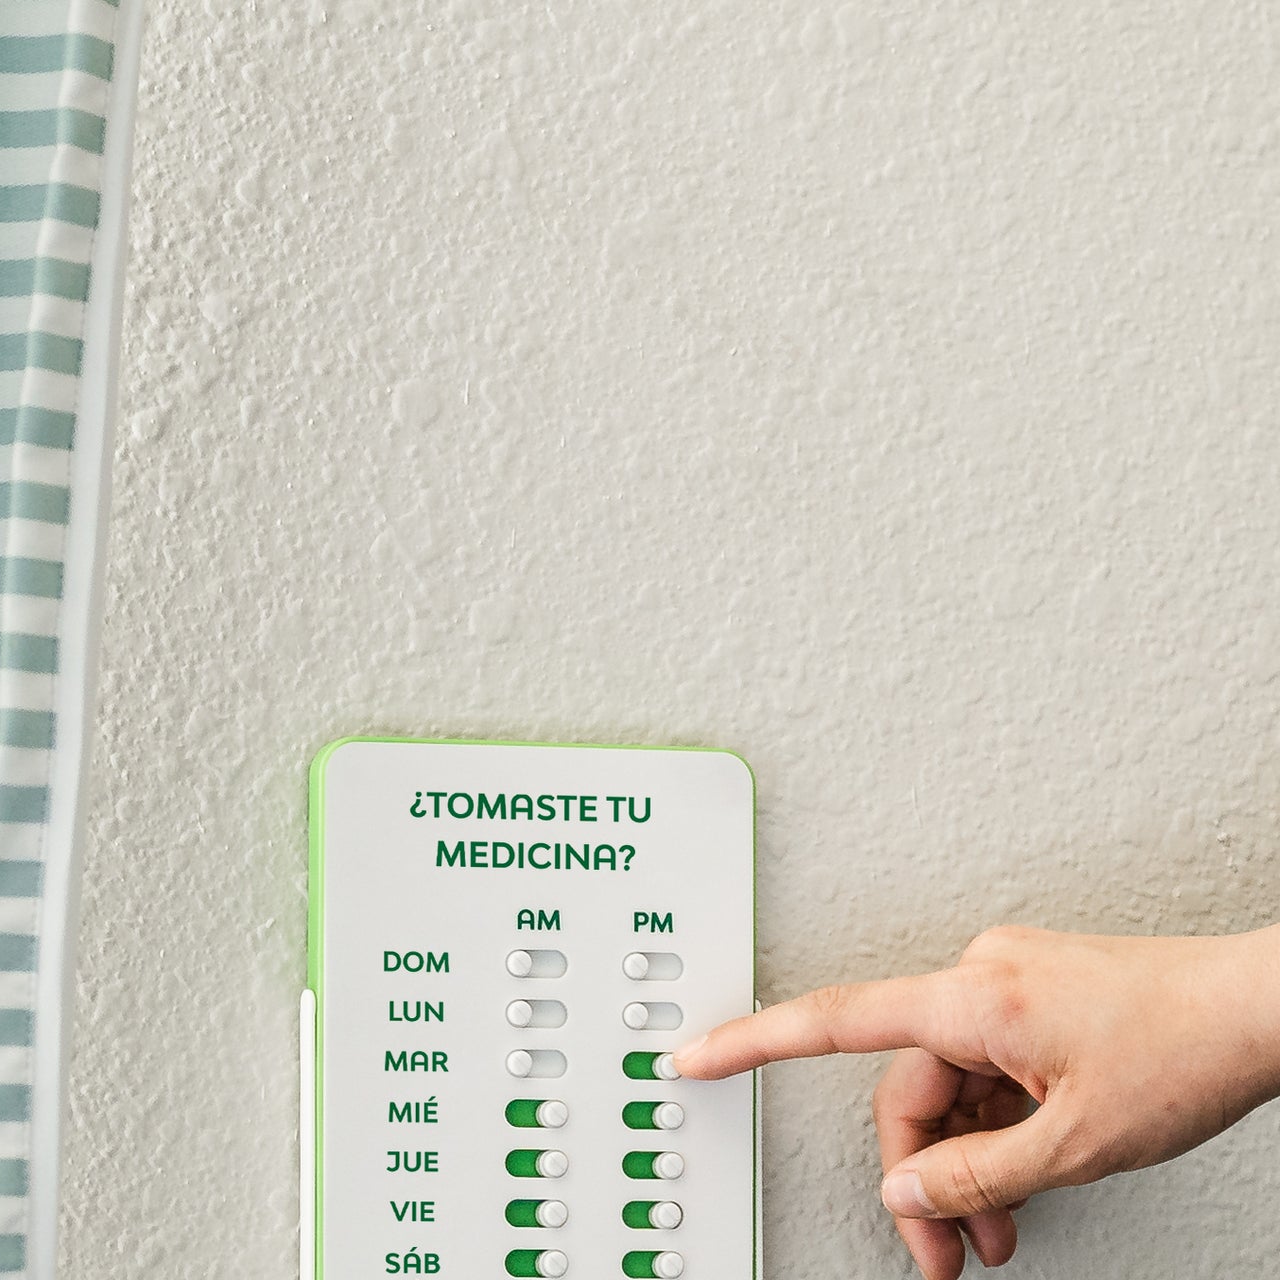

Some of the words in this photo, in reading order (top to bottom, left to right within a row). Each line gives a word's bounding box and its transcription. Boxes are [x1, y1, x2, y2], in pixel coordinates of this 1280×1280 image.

[410, 792, 597, 822] ¿TOMASTE
[606, 796, 651, 823] TU
[436, 841, 635, 871] MEDICINA?
[518, 909, 561, 931] AM
[634, 912, 673, 933] PM
[384, 951, 450, 973] DOM
[389, 1001, 444, 1022] LUN
[385, 1051, 449, 1072] MAR
[389, 1096, 438, 1123] MIÉ
[387, 1151, 439, 1173] JUE
[390, 1201, 435, 1222] VIE
[385, 1247, 441, 1274] SÁB
